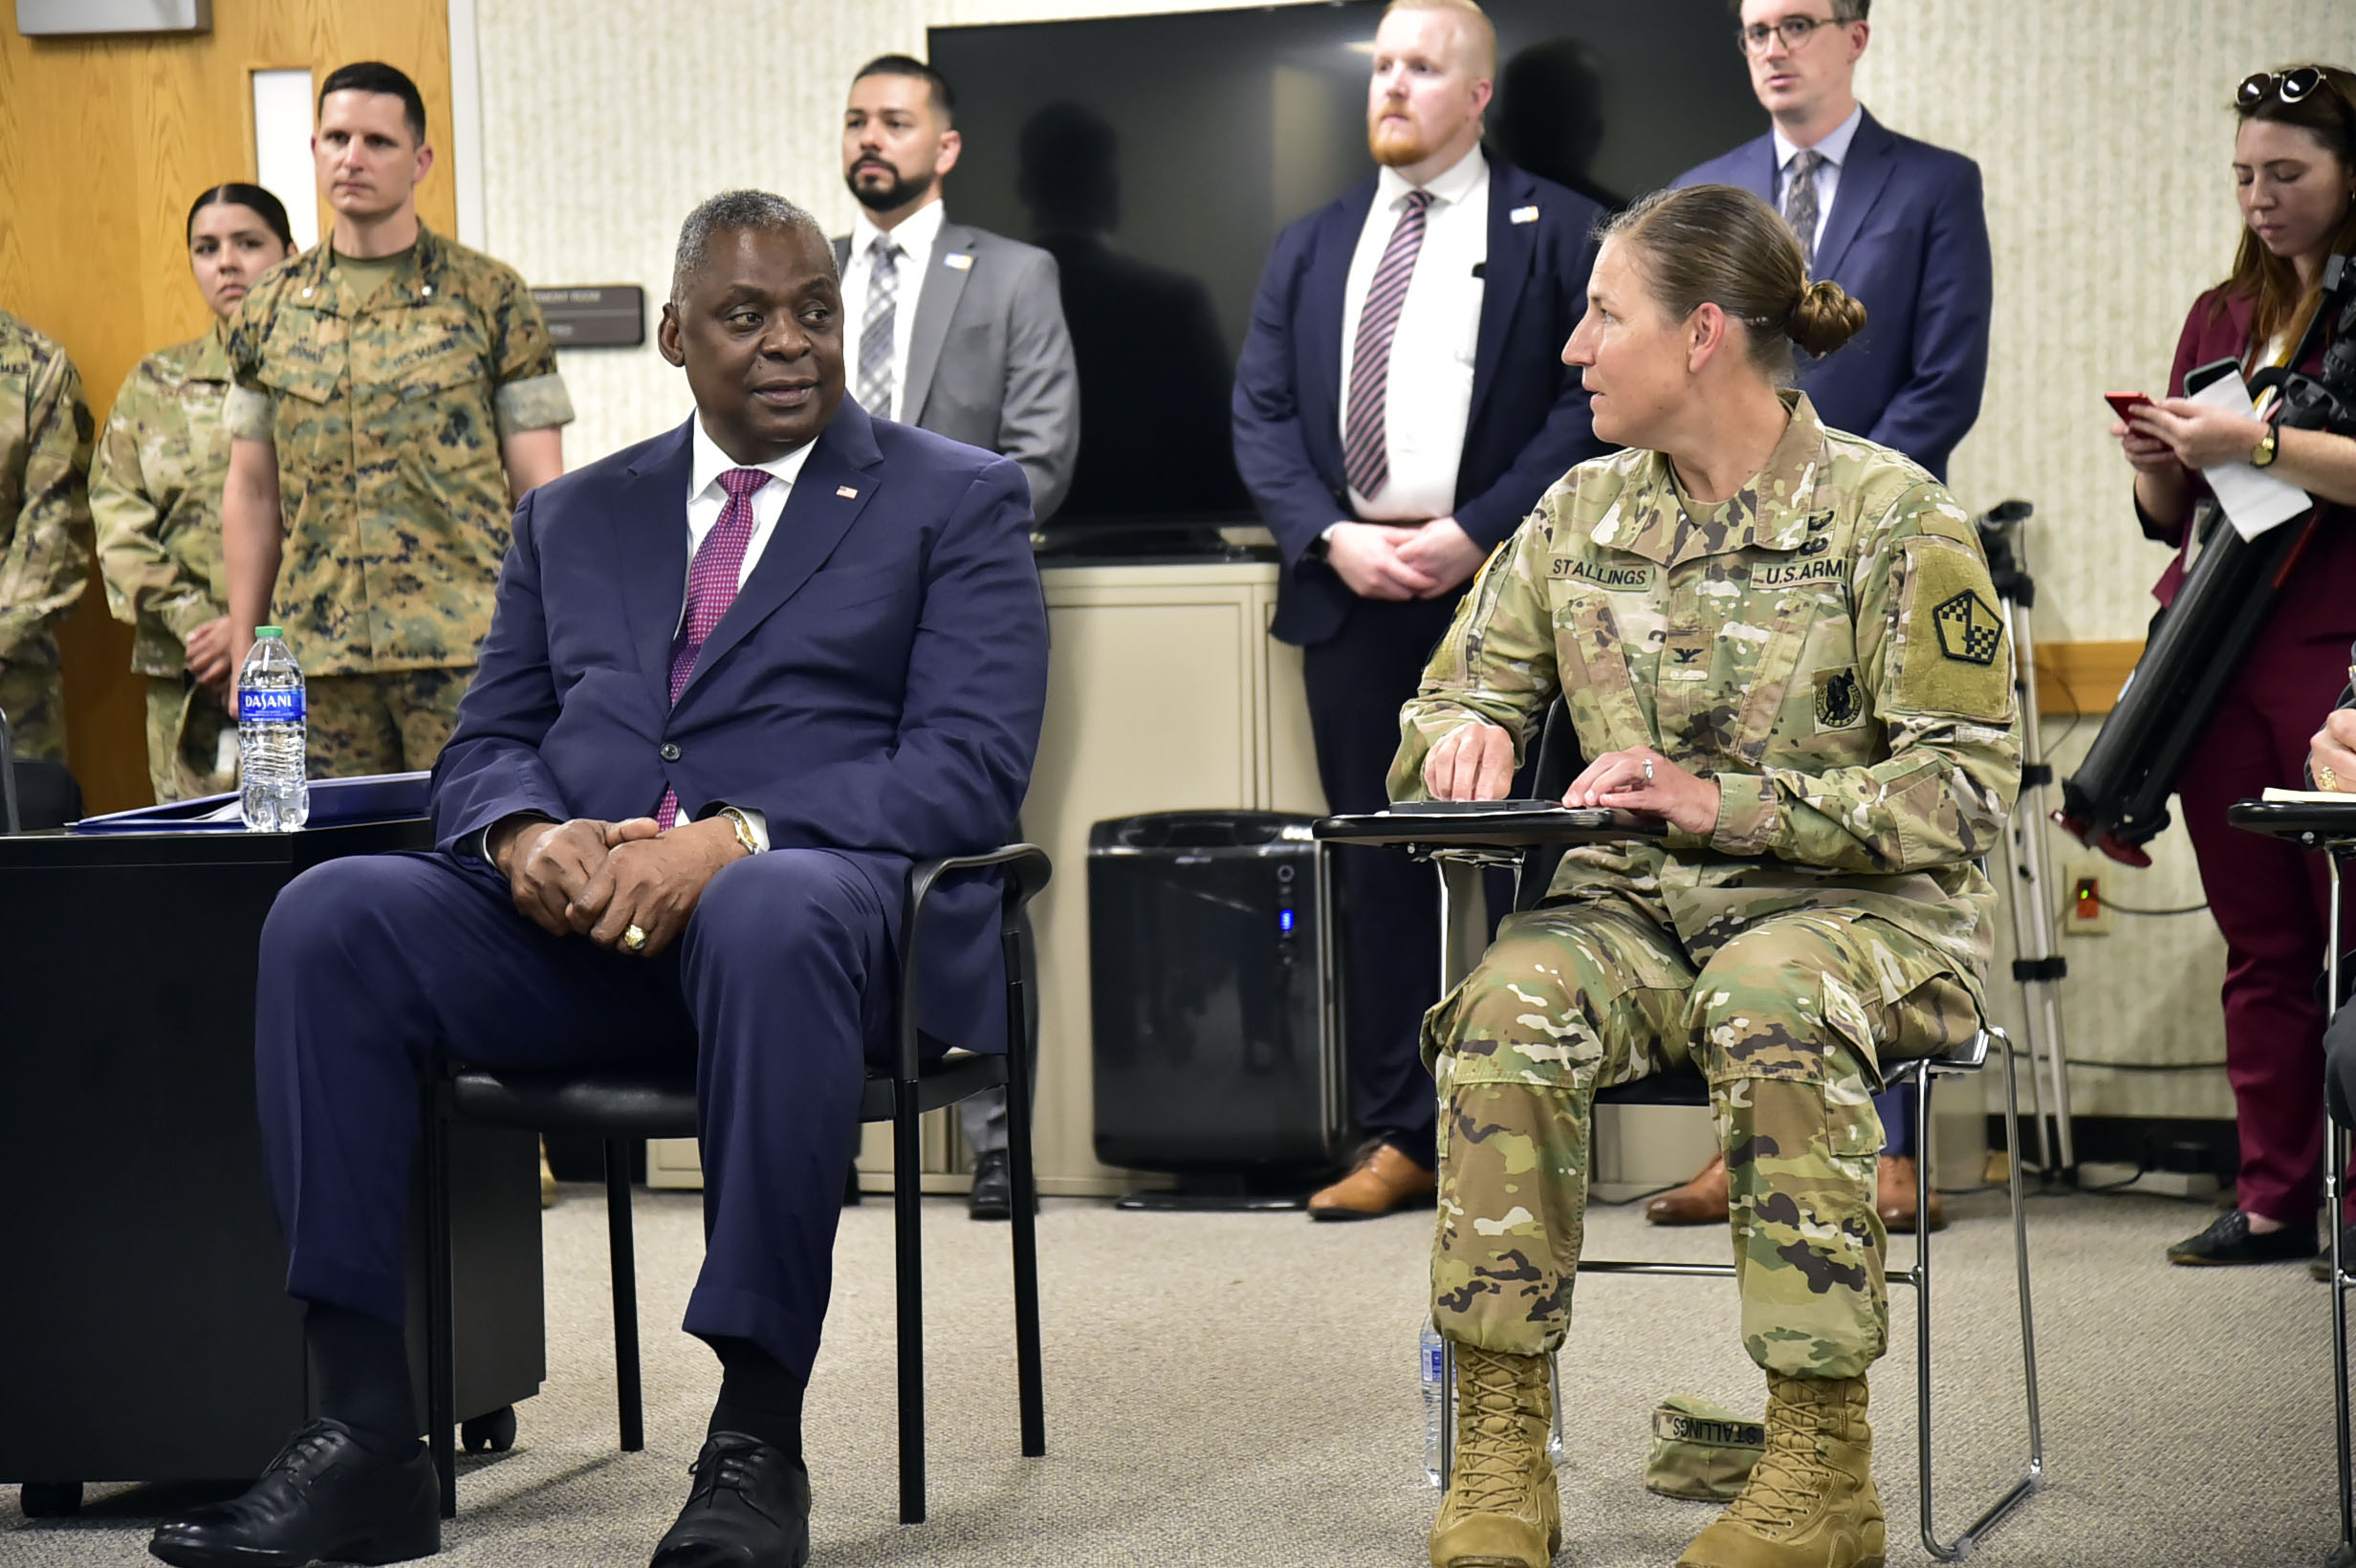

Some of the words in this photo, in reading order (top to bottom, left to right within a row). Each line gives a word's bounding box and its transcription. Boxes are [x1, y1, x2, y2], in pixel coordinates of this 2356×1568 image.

[1552, 558, 1647, 585] STALLINGS
[1766, 558, 1843, 585] U.S.ARM
[245, 692, 293, 710] DASANI
[1672, 1417, 1757, 1445] STALLINGS
